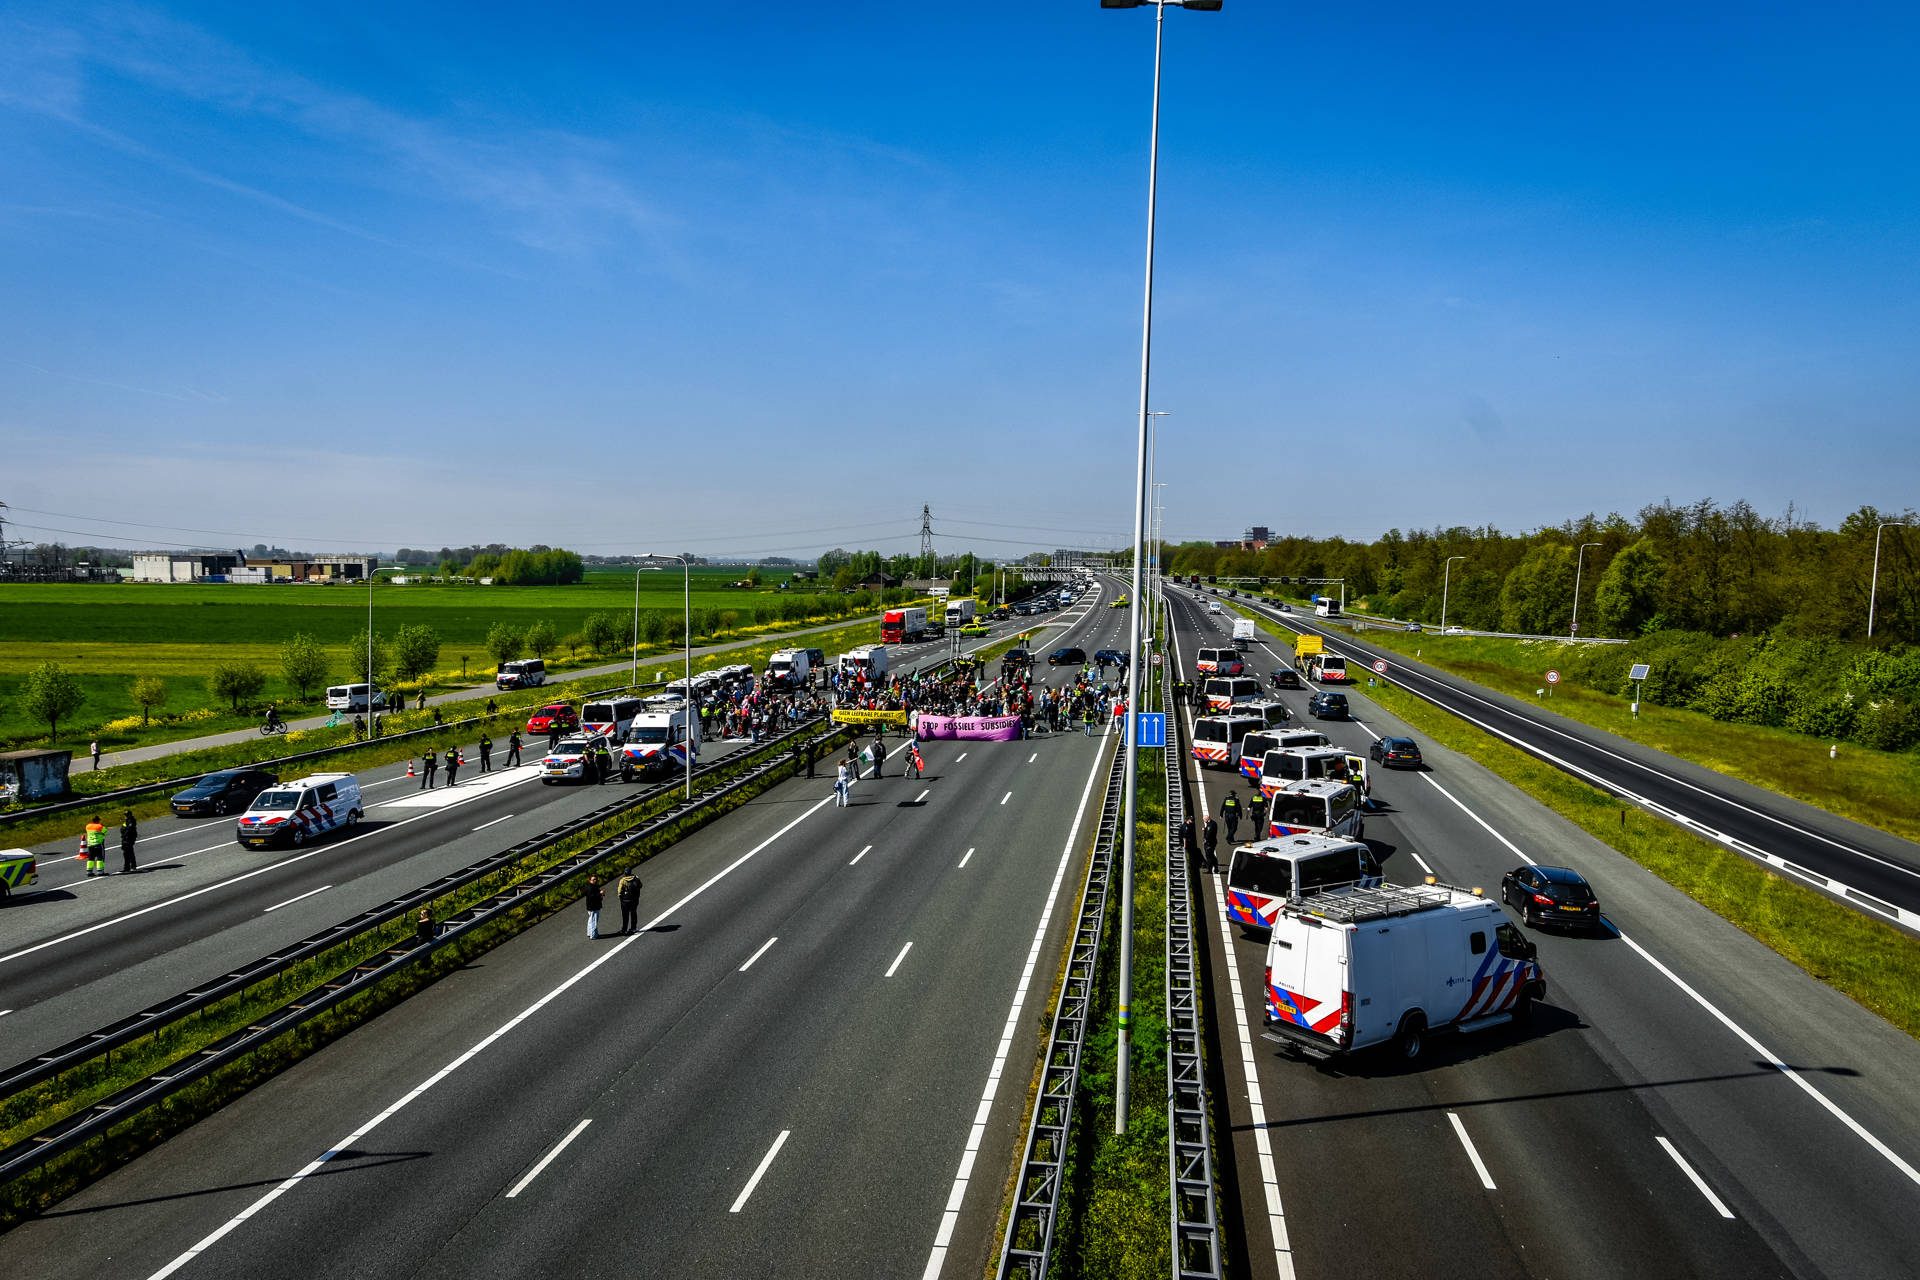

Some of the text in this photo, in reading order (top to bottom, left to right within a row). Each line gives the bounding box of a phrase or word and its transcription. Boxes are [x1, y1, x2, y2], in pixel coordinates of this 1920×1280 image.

[922, 719, 1016, 731] STOP FOSSIELE SUBSIDIES
